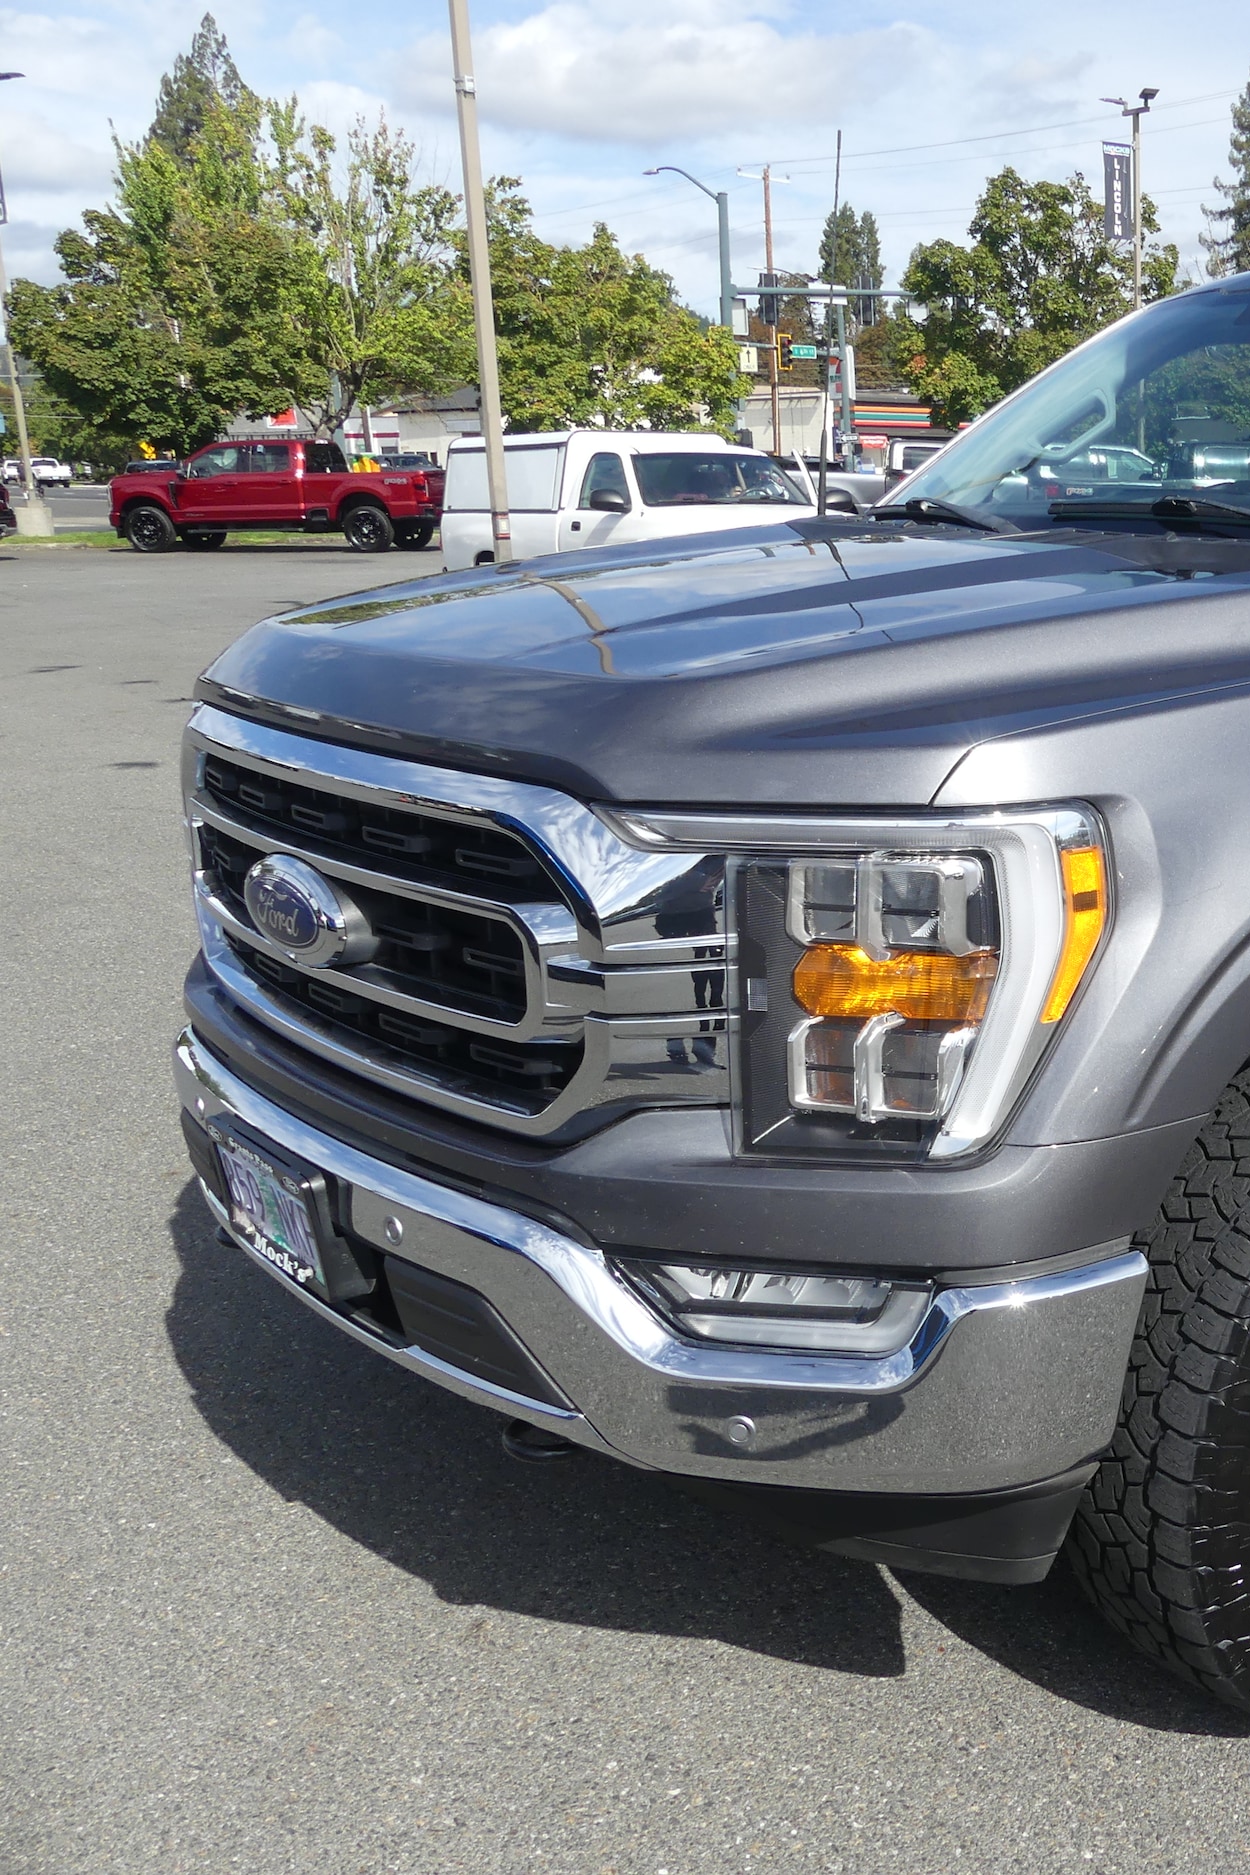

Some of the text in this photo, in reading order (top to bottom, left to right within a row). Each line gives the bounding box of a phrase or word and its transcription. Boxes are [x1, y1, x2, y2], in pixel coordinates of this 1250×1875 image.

[1113, 157, 1122, 236] LINCOLN
[257, 885, 299, 937] Ford
[222, 1151, 266, 1221] 859
[253, 1231, 307, 1283] Mock's
